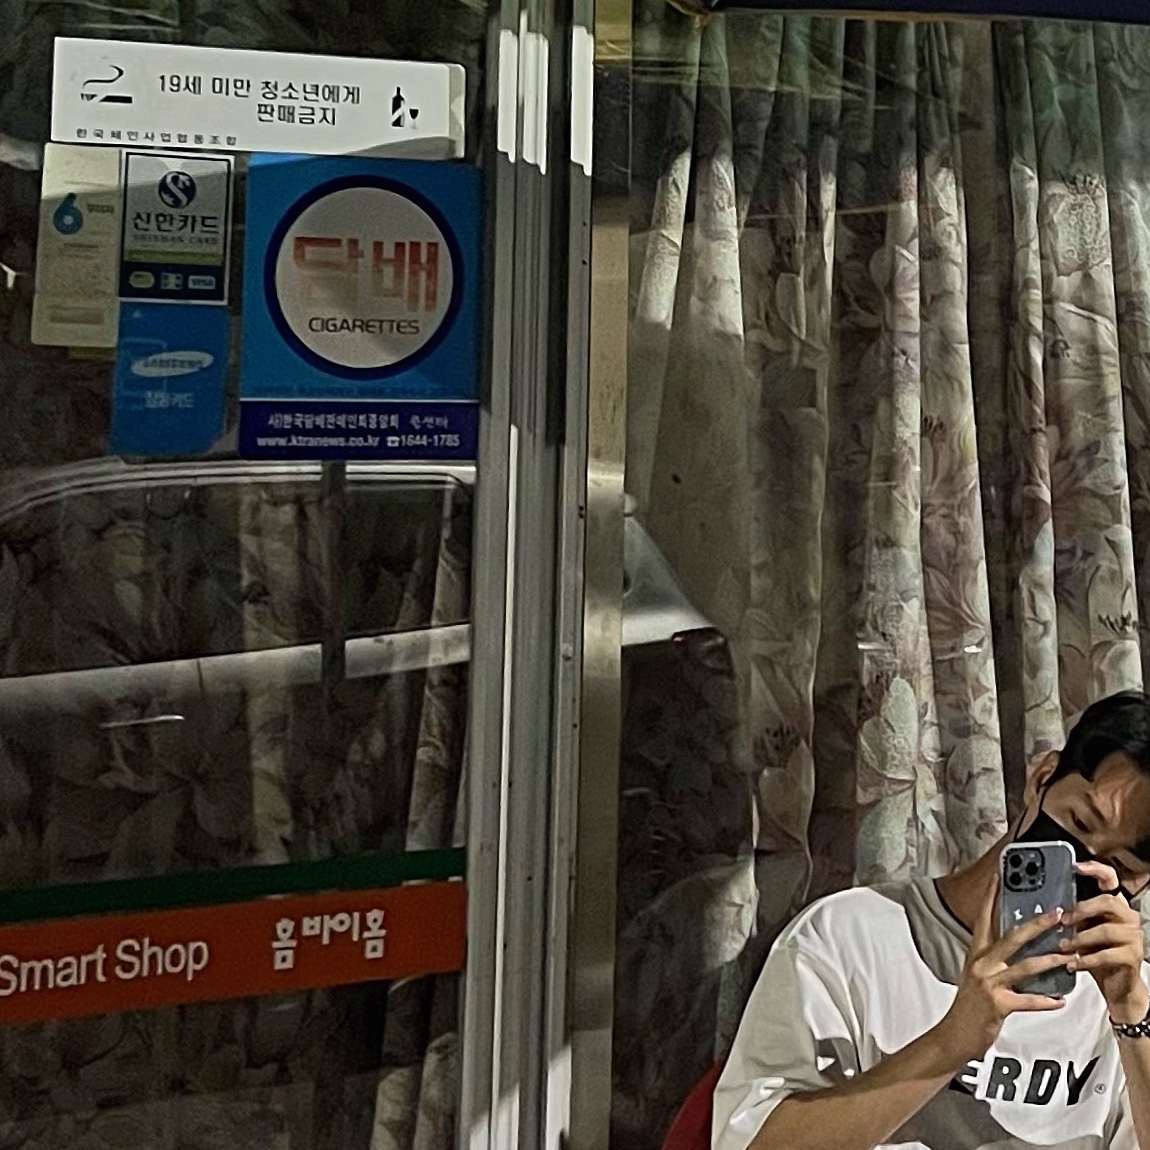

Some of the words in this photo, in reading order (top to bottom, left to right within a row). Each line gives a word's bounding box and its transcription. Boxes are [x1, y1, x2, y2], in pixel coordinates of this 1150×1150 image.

[159, 74, 203, 95] 19세
[212, 77, 251, 98] 미만
[261, 80, 361, 105] 청소년에게
[257, 103, 336, 126] 판매금지
[133, 211, 220, 234] 신한카드
[308, 317, 421, 335] CIGARETTES
[272, 908, 388, 971] 홈바이홈
[0, 942, 107, 997] Smart
[114, 936, 209, 981] Shop
